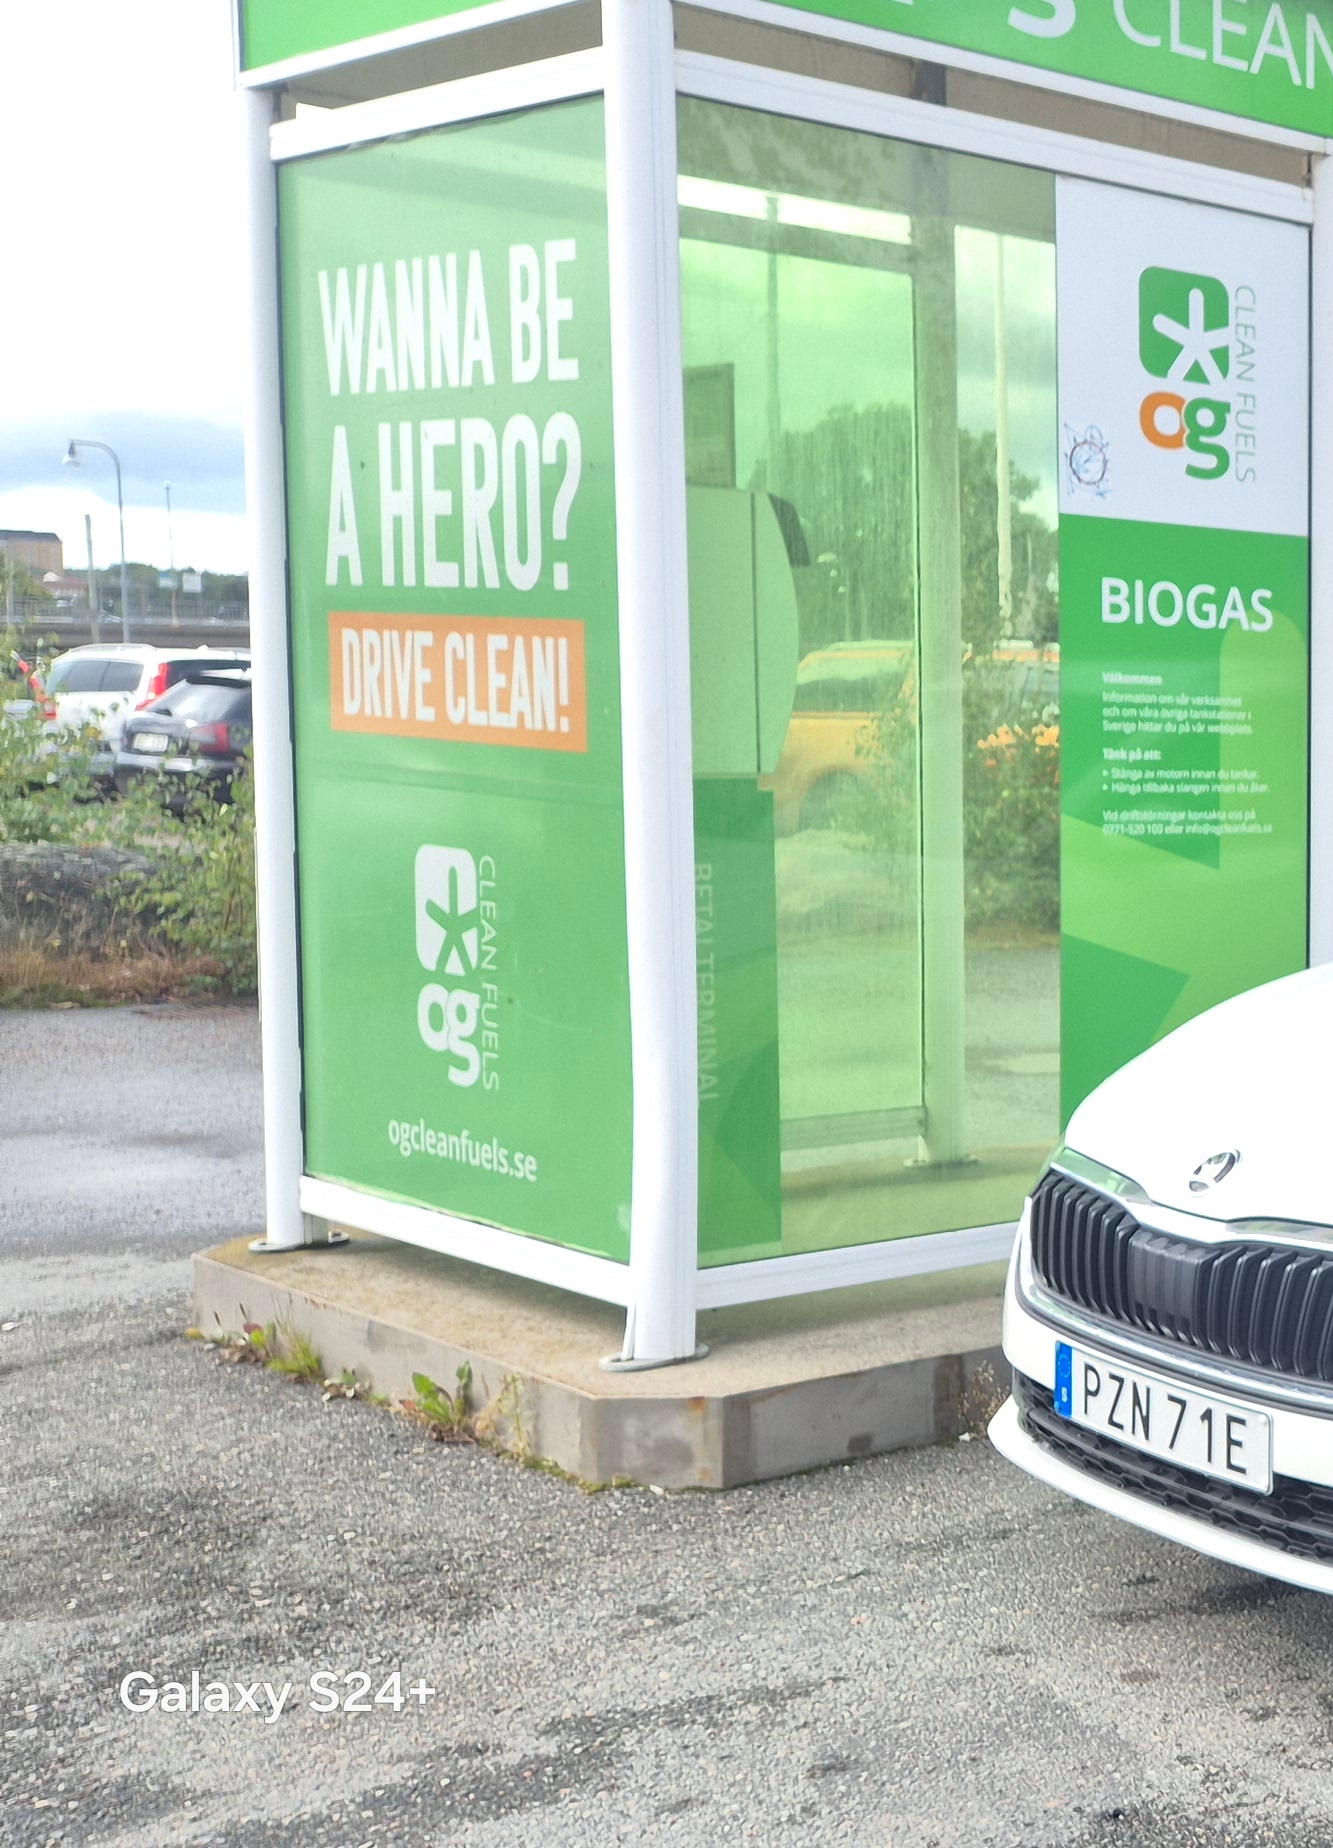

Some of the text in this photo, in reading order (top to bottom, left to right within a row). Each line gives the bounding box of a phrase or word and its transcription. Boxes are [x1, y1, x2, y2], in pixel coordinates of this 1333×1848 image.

[318, 238, 580, 397] WANNA BE
[1139, 391, 1232, 480] og
[1234, 284, 1257, 484] CLEAN FUELS
[325, 411, 583, 591] A HERO?
[1101, 577, 1274, 633] BIOGAS
[341, 628, 570, 733] DRIVE CLEAN!
[478, 855, 500, 1091] CLEAN FUELS
[417, 983, 481, 1088] og
[388, 1118, 538, 1183] ogcleanfuels.se
[1084, 1361, 1248, 1476] PZN 71E
